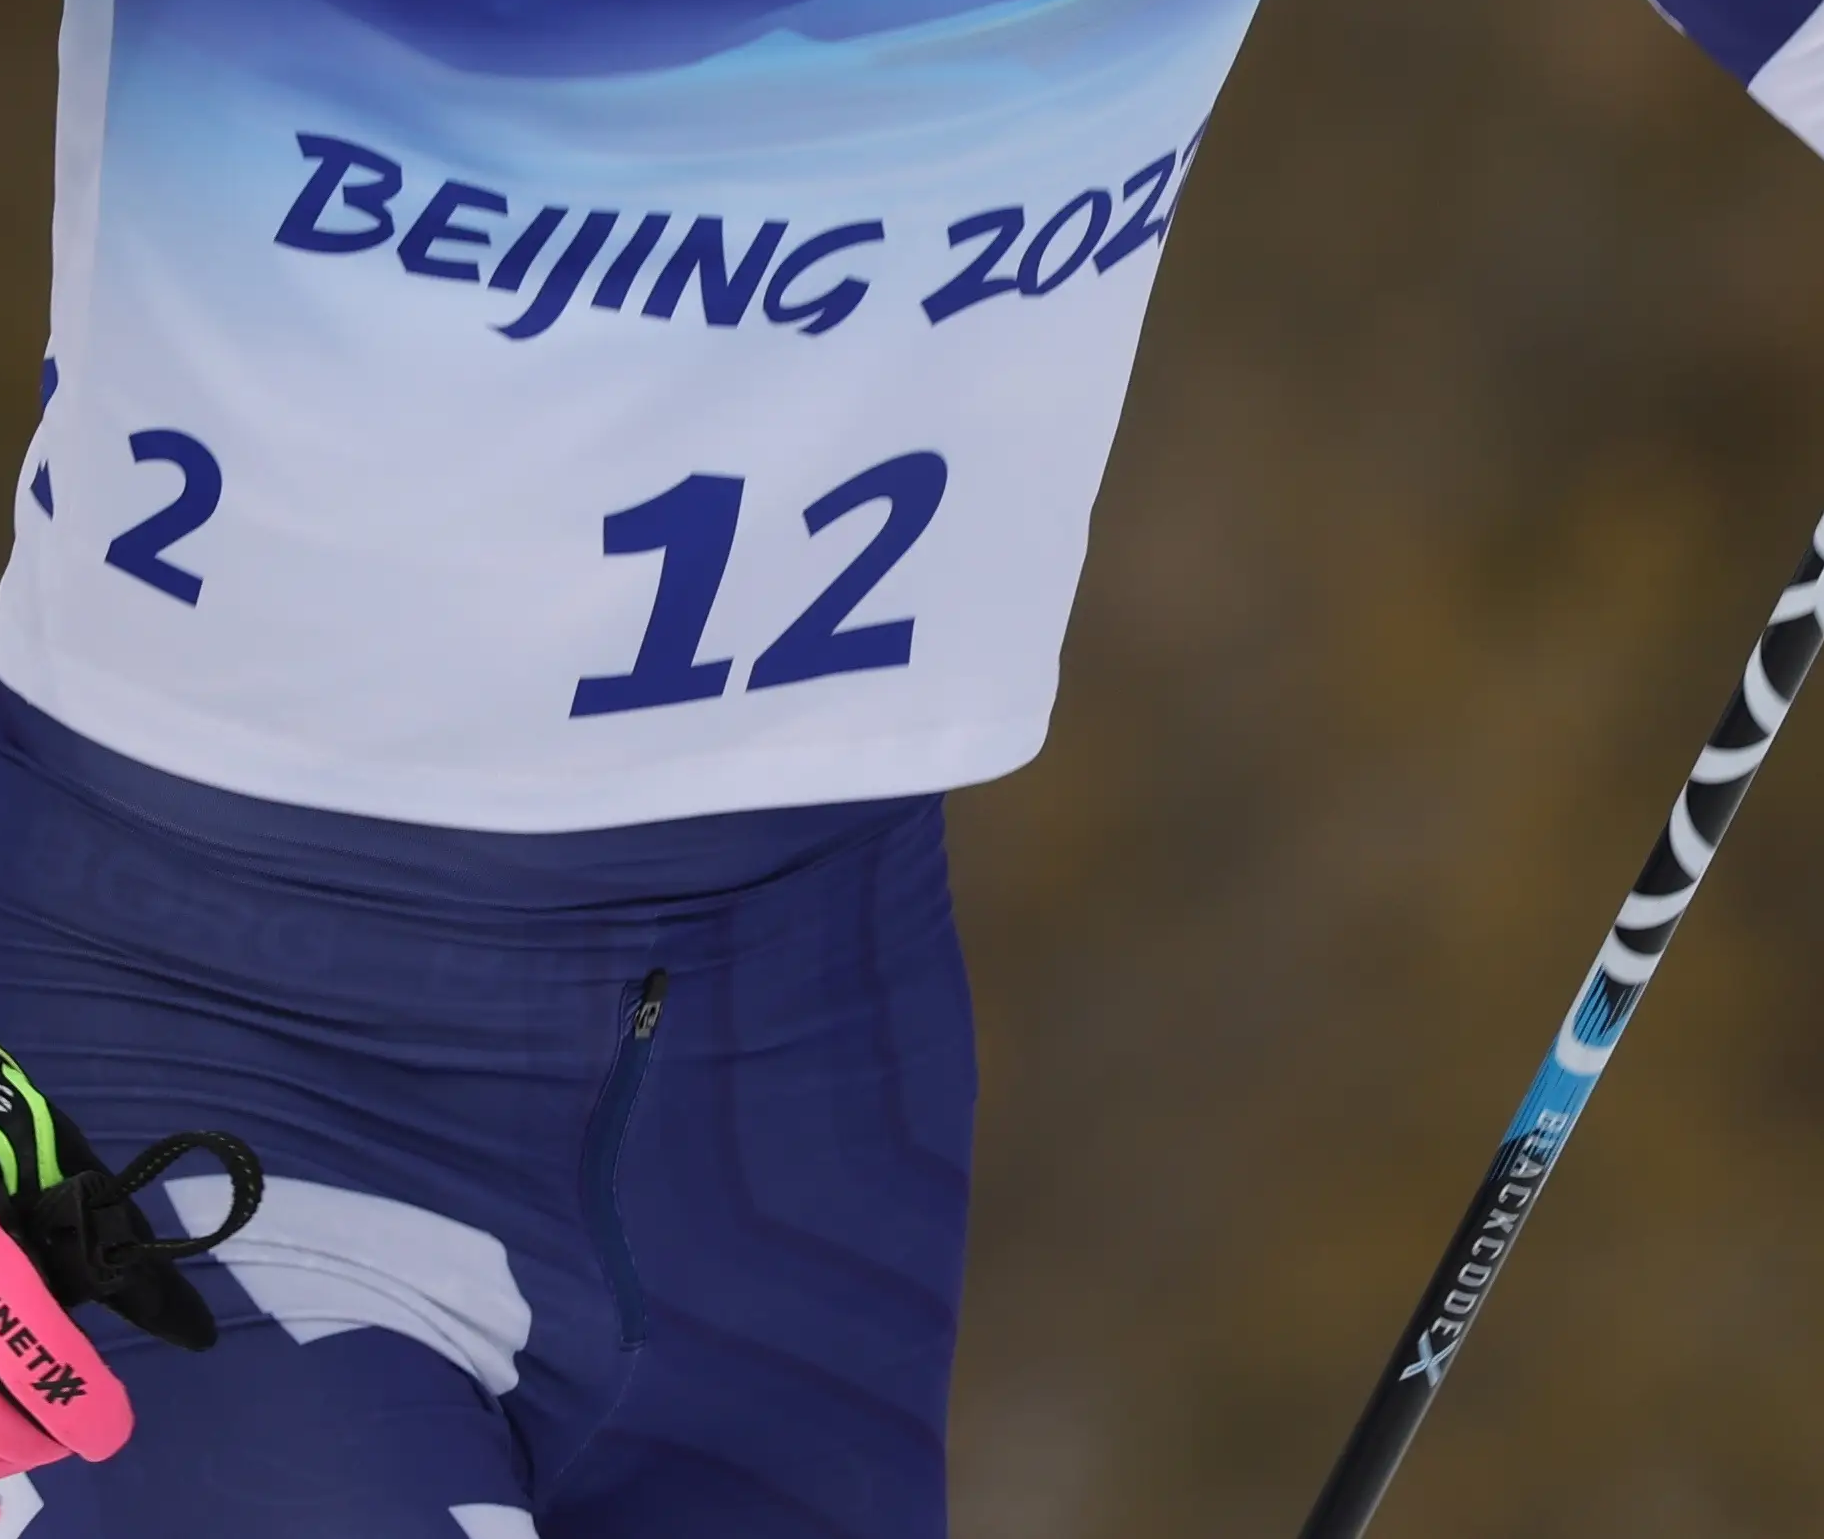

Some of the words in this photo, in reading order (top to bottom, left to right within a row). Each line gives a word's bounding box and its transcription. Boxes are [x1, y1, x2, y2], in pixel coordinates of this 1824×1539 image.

[274, 129, 885, 342] BEIJING
[920, 111, 1212, 327] 202
[568, 449, 948, 720] 12
